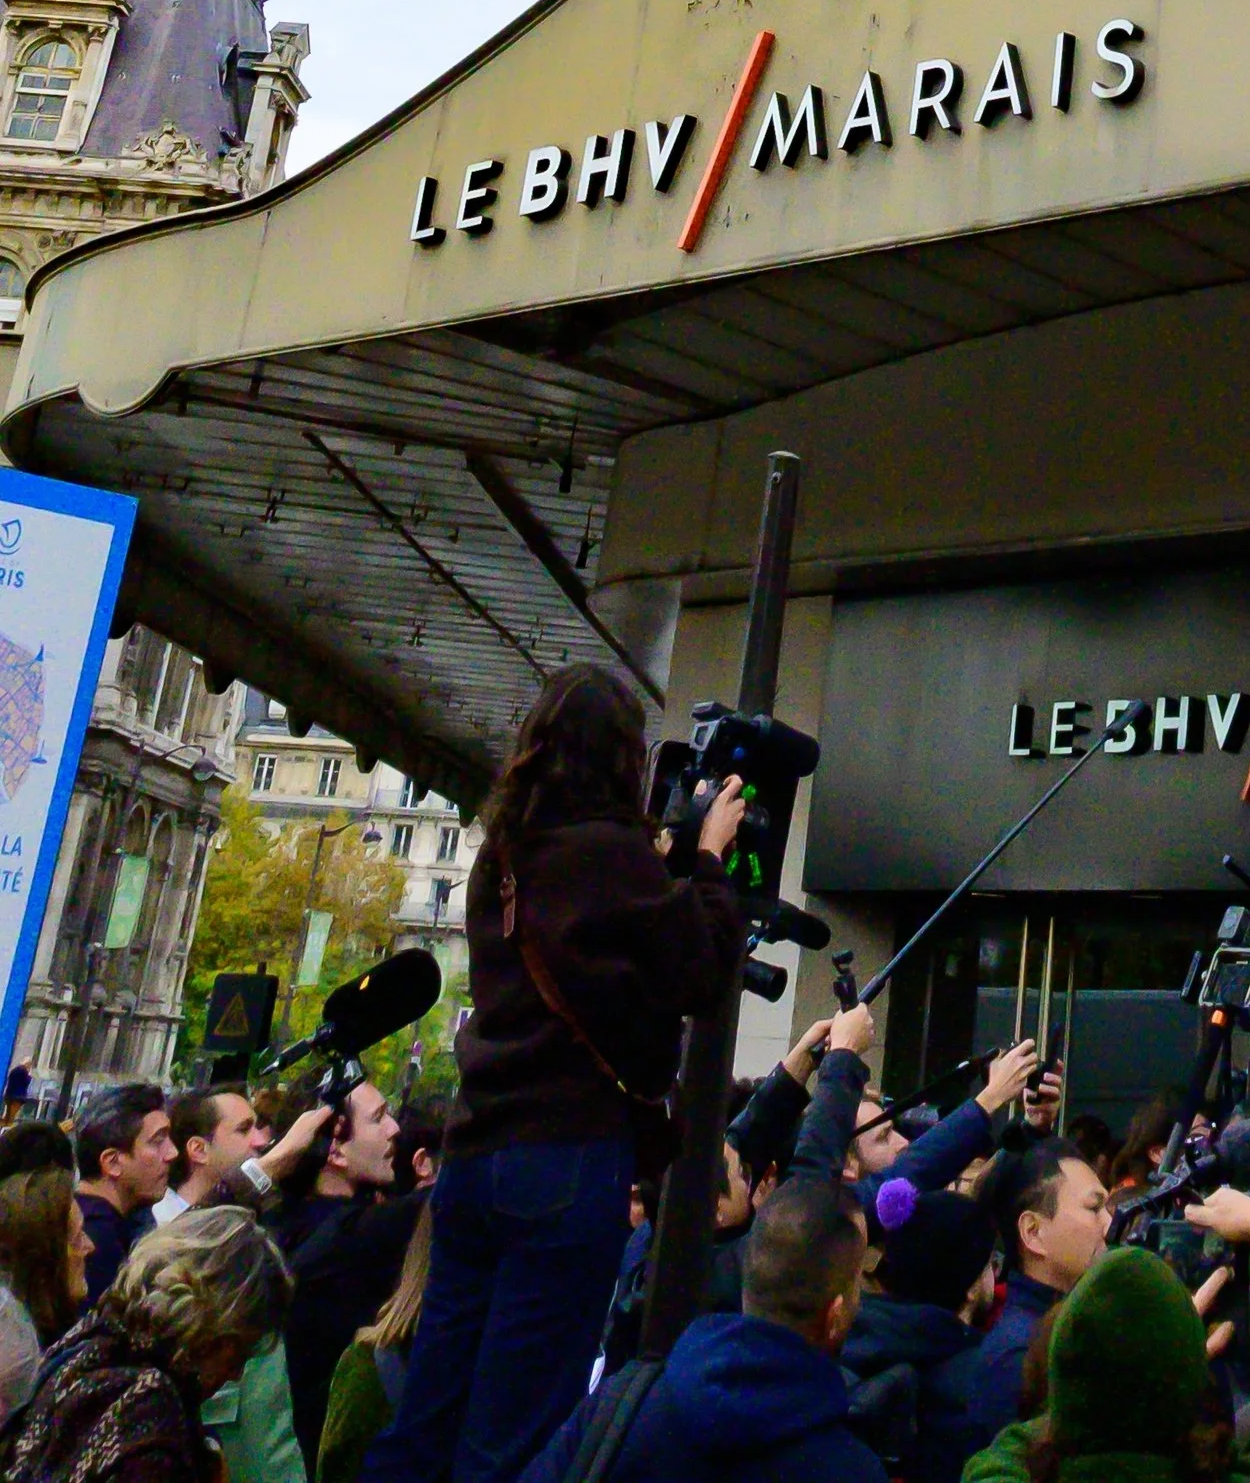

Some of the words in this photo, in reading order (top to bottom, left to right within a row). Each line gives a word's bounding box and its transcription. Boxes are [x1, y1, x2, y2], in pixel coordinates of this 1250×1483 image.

[410, 159, 504, 247] LE
[1008, 701, 1077, 756] LE
[1, 834, 22, 856] LA
